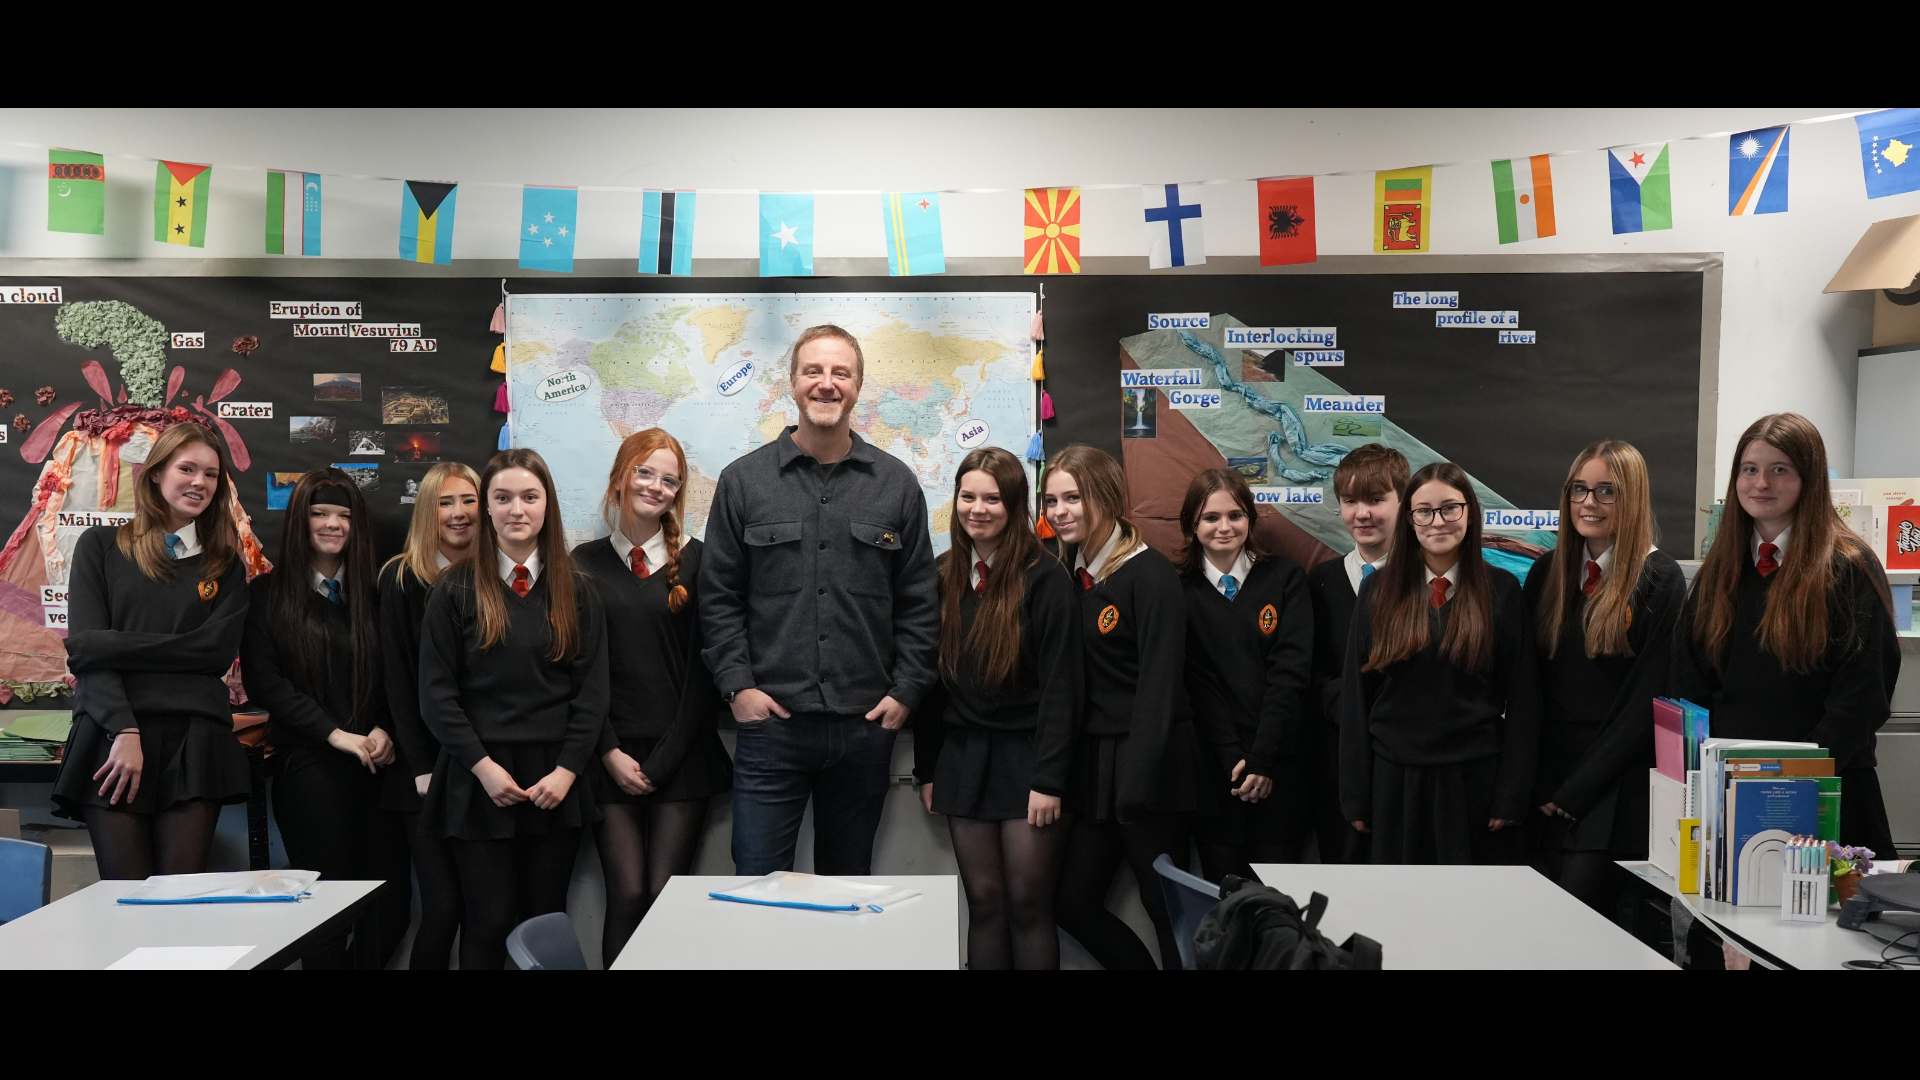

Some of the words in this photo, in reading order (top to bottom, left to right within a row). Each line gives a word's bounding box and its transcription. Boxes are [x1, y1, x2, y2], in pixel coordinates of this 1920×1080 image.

[11, 287, 61, 303] cloud
[1394, 292, 1421, 305] The
[1425, 292, 1458, 307] long
[271, 302, 341, 318] Eruption
[345, 302, 362, 316] of
[1149, 315, 1208, 329] Source
[1436, 311, 1486, 327] profile
[1491, 311, 1505, 324] of
[1509, 315, 1517, 324] a
[294, 324, 347, 336] Mount
[349, 324, 420, 336] Vesuvius
[1227, 328, 1334, 347] Interlocking
[1500, 331, 1535, 343] river
[173, 334, 204, 347] Gas
[390, 339, 408, 352] 79
[412, 339, 436, 352] AD
[1294, 351, 1344, 365] spurs
[547, 372, 576, 387] North
[719, 362, 753, 392] Europe
[1122, 369, 1201, 386] Waterfall
[544, 383, 587, 400] America
[1170, 390, 1220, 407] Gorge
[220, 403, 271, 417] Crater
[1305, 397, 1383, 411] Meander
[961, 426, 984, 442] Asia
[1286, 488, 1322, 503] lake
[58, 513, 103, 527] Main
